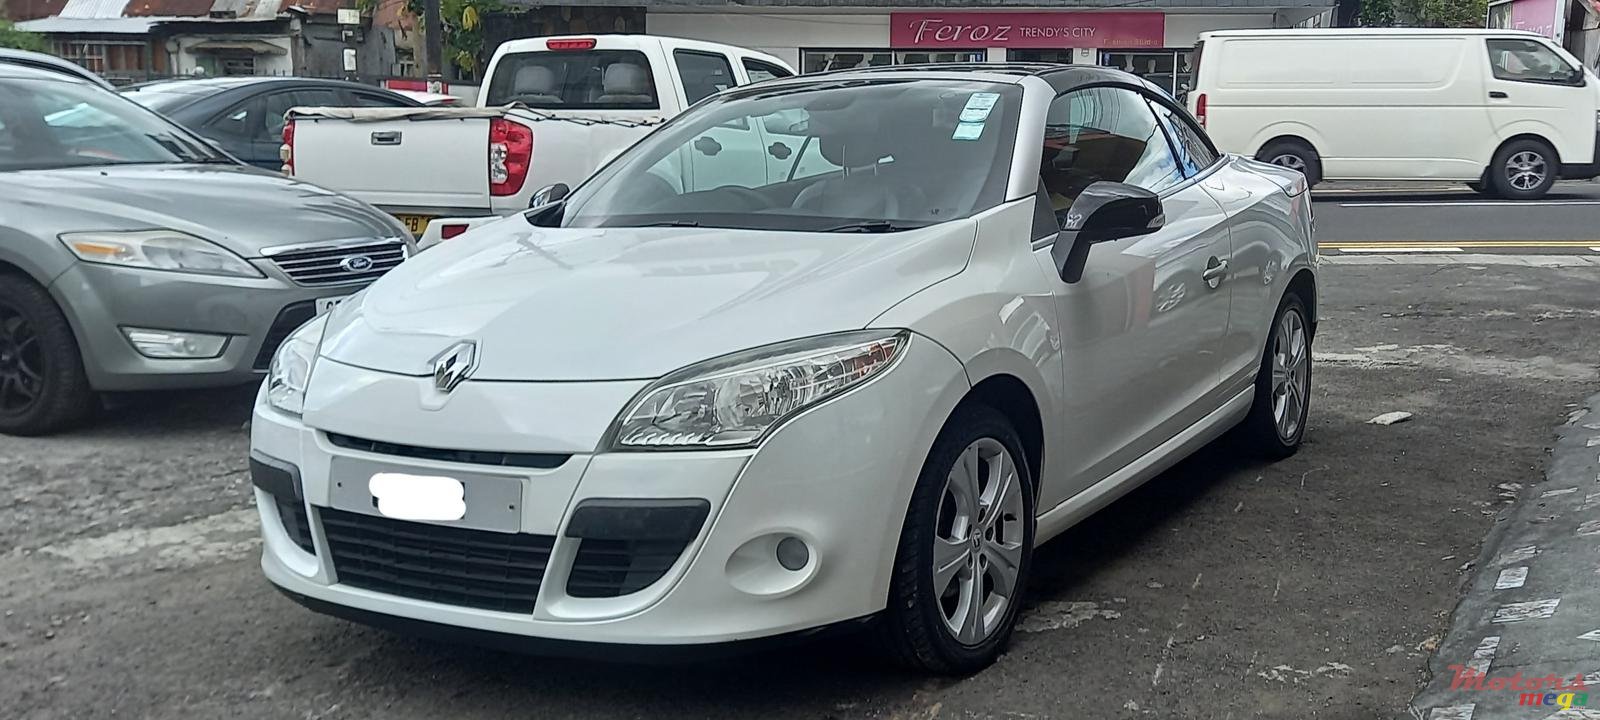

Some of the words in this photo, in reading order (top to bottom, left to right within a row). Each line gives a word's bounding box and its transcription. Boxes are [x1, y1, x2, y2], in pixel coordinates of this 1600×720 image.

[910, 19, 1011, 44] Feroz
[1019, 27, 1070, 38] TRENDY'S
[1072, 27, 1096, 38] CITY
